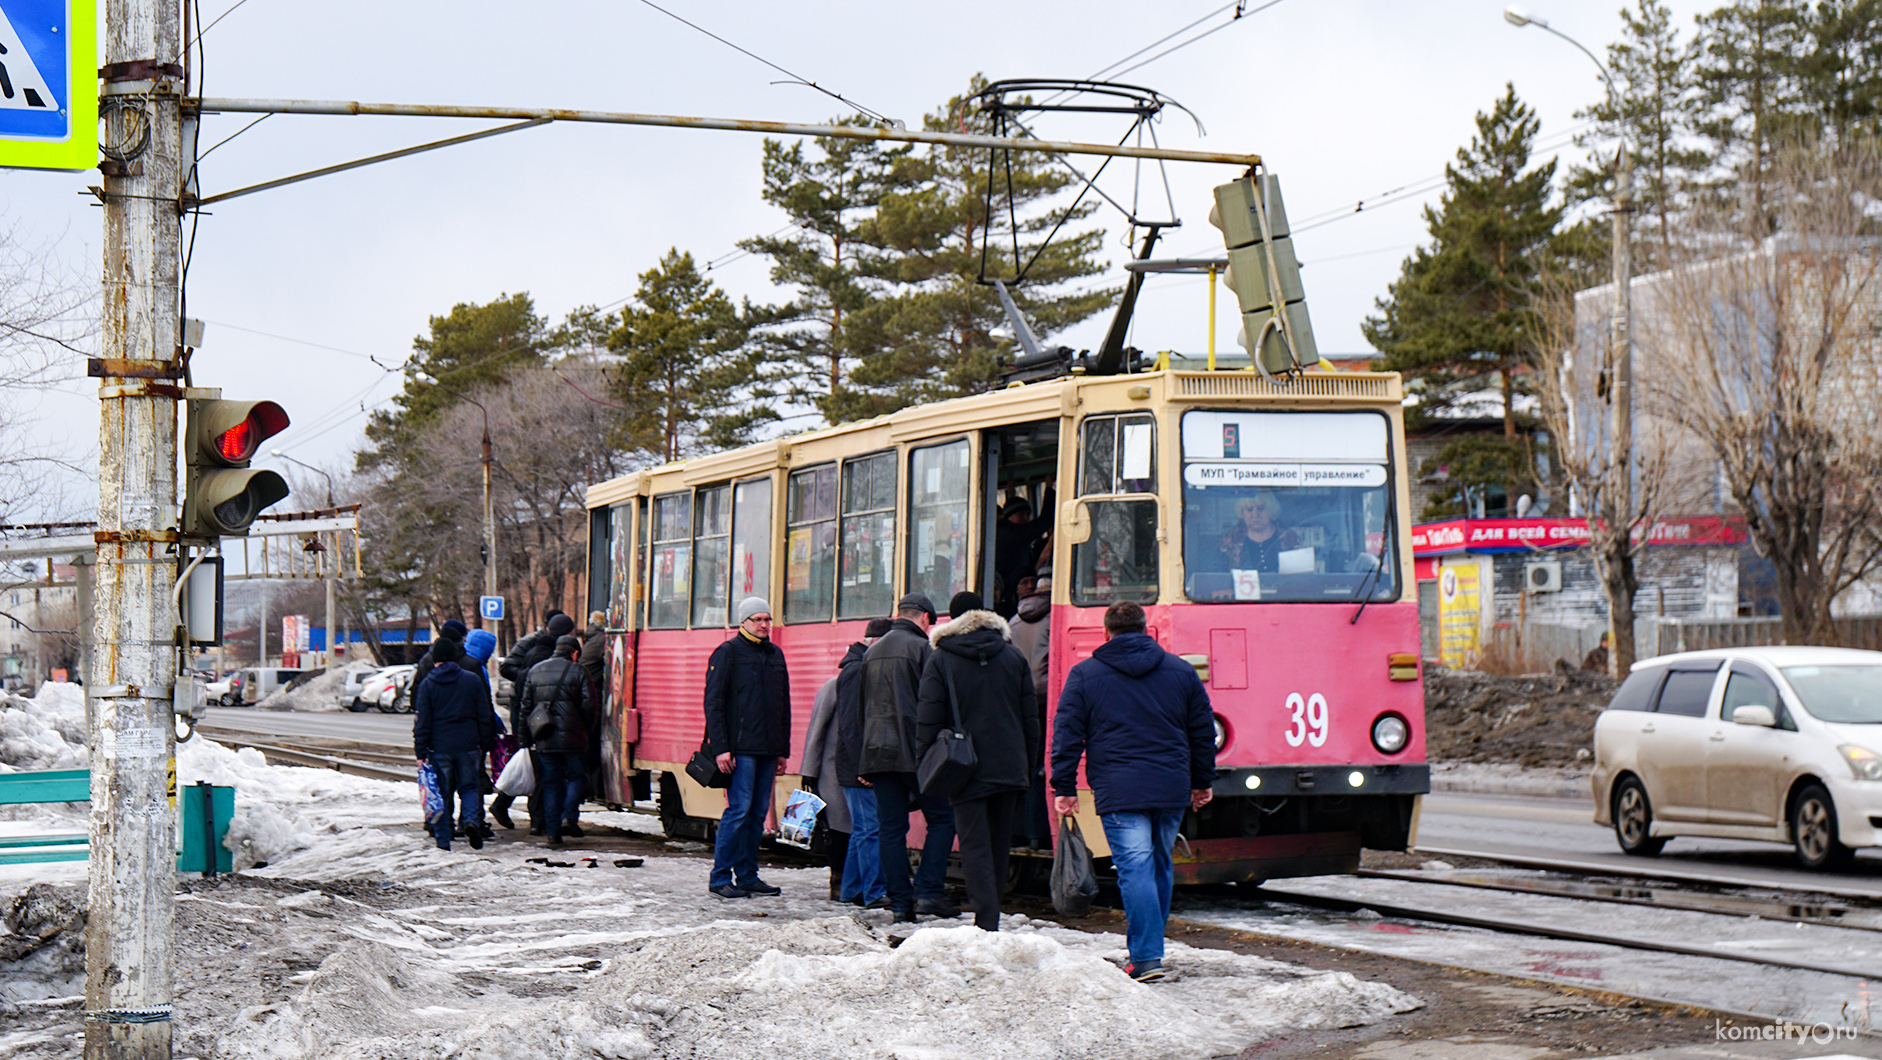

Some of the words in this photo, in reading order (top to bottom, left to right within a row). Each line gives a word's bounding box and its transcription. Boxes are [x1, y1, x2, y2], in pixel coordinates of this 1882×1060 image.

[1224, 427, 1236, 446] 5
[1201, 468, 1225, 478] МУП
[1471, 527, 1503, 541] ДЛЯ
[1508, 526, 1546, 540] ВСЕЙ
[744, 552, 753, 593] 39
[1239, 574, 1255, 596] 5
[487, 601, 499, 616] P
[1285, 692, 1329, 747] 39
